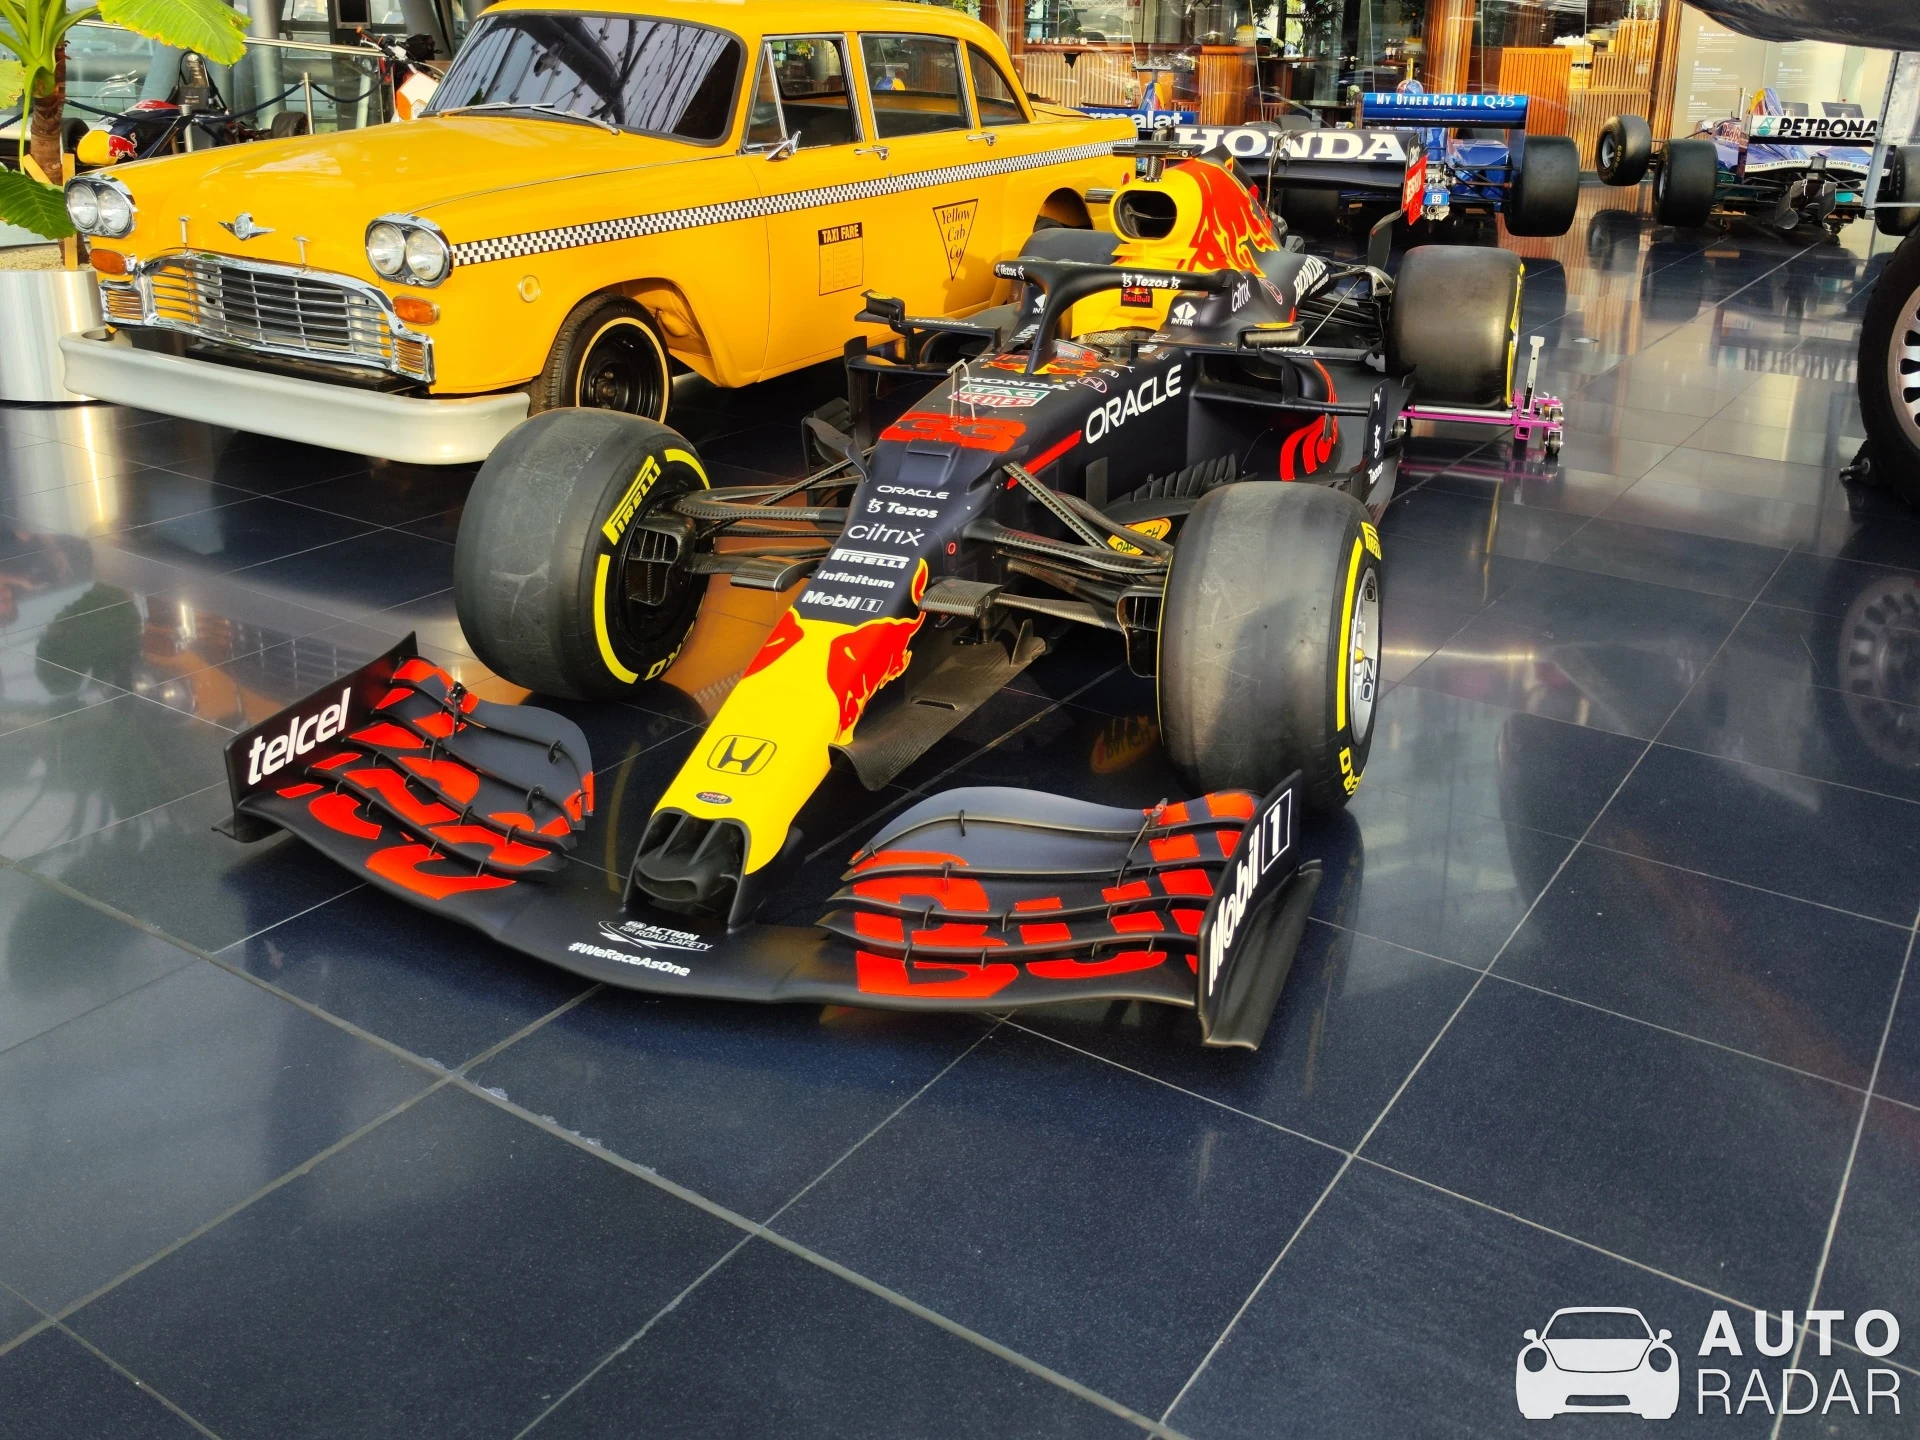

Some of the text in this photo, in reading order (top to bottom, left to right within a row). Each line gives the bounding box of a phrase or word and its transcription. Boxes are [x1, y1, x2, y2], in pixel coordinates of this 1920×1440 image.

[1484, 95, 1516, 109] Q45
[1175, 128, 1407, 160] HONDA
[941, 207, 972, 225] Yellow
[821, 224, 860, 244] TAXI FARE
[947, 223, 966, 243] Cab
[1134, 274, 1169, 288] Tezos
[1171, 317, 1194, 327] INTER
[959, 375, 1070, 391] HONDA
[970, 386, 1039, 398] TAG
[1085, 364, 1182, 444] ORACLE
[876, 485, 951, 500] ORACLE
[886, 501, 939, 519] Tezos
[830, 548, 910, 570] PIRELLI
[801, 590, 862, 610] Mobil
[247, 686, 352, 786] telcel
[1208, 823, 1260, 998] Mobil
[619, 925, 714, 950] FOR ROAD SAFETY
[644, 925, 701, 941] ACTION
[568, 941, 691, 977] #WeRaceAsOne
